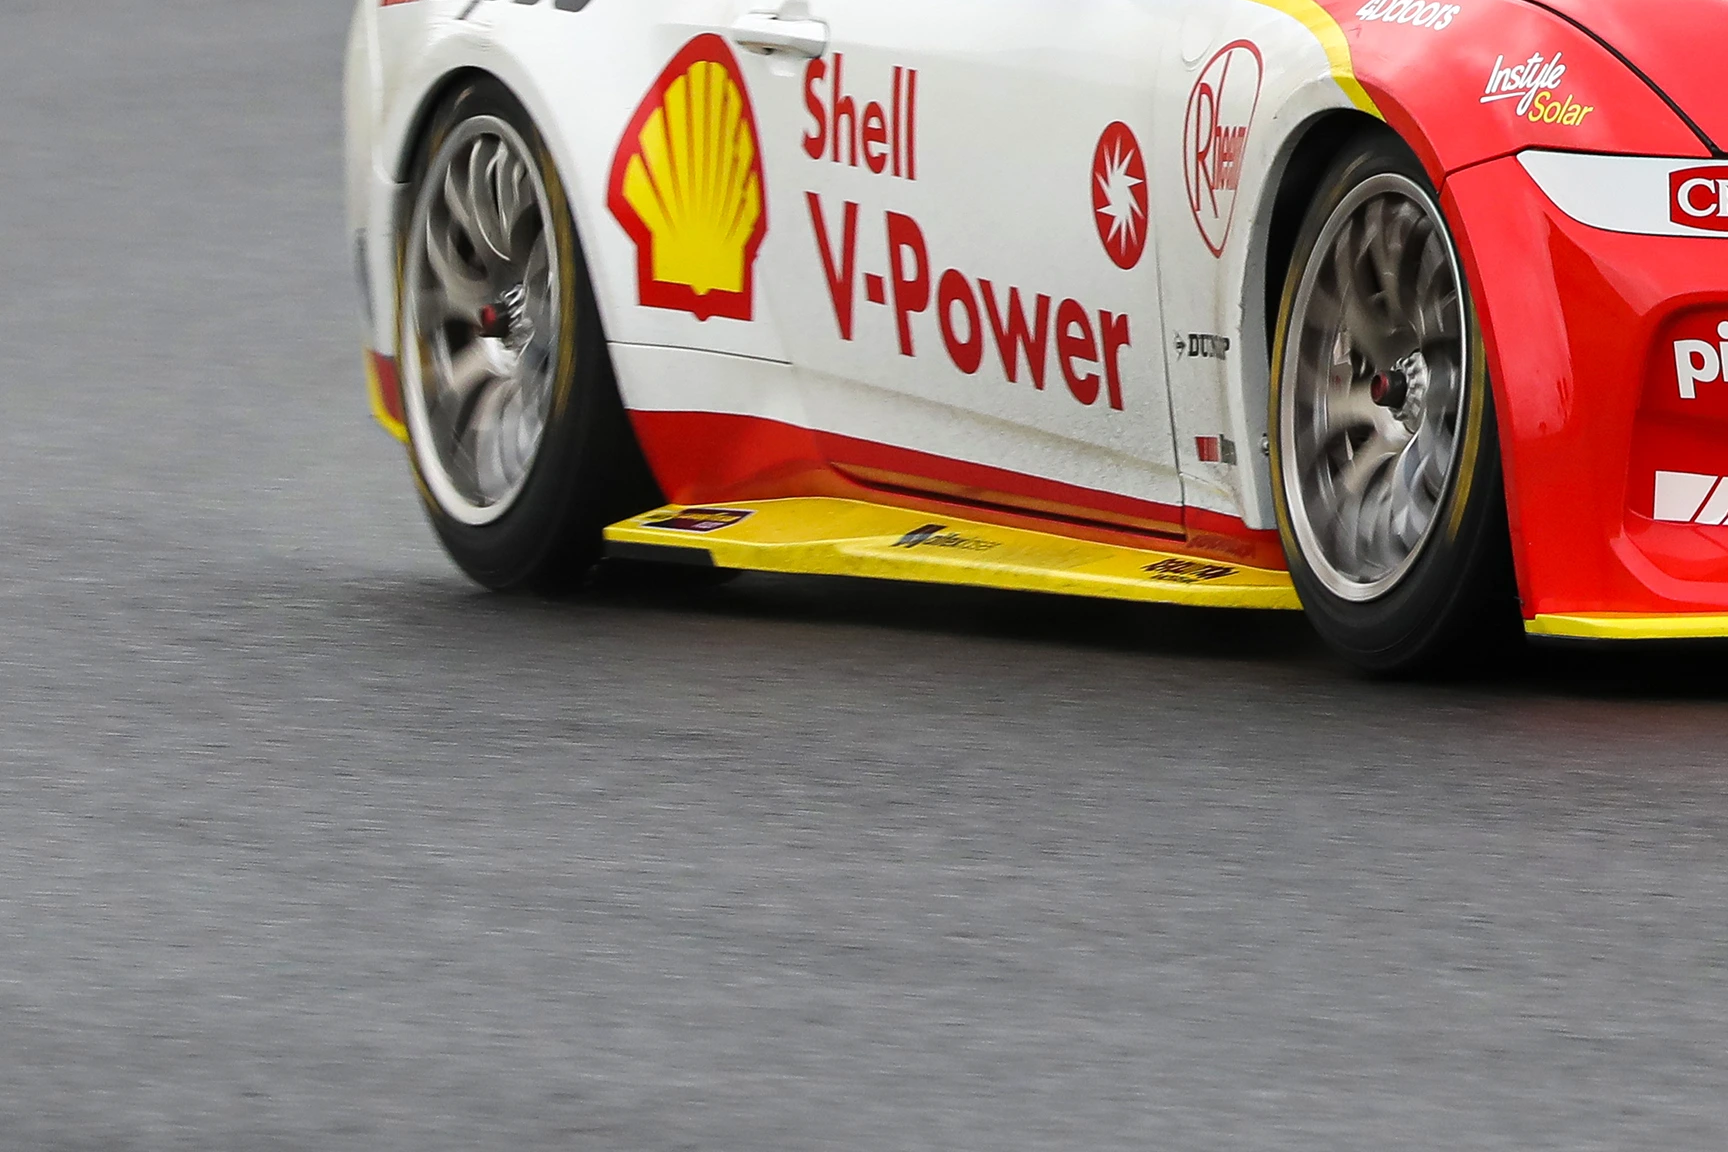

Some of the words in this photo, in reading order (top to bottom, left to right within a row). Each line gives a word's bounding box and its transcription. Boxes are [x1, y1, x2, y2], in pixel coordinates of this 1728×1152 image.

[802, 52, 918, 181] Shell
[1480, 51, 1567, 116] Instyle
[1528, 91, 1594, 126] Solar
[803, 191, 1131, 411] V-Power
